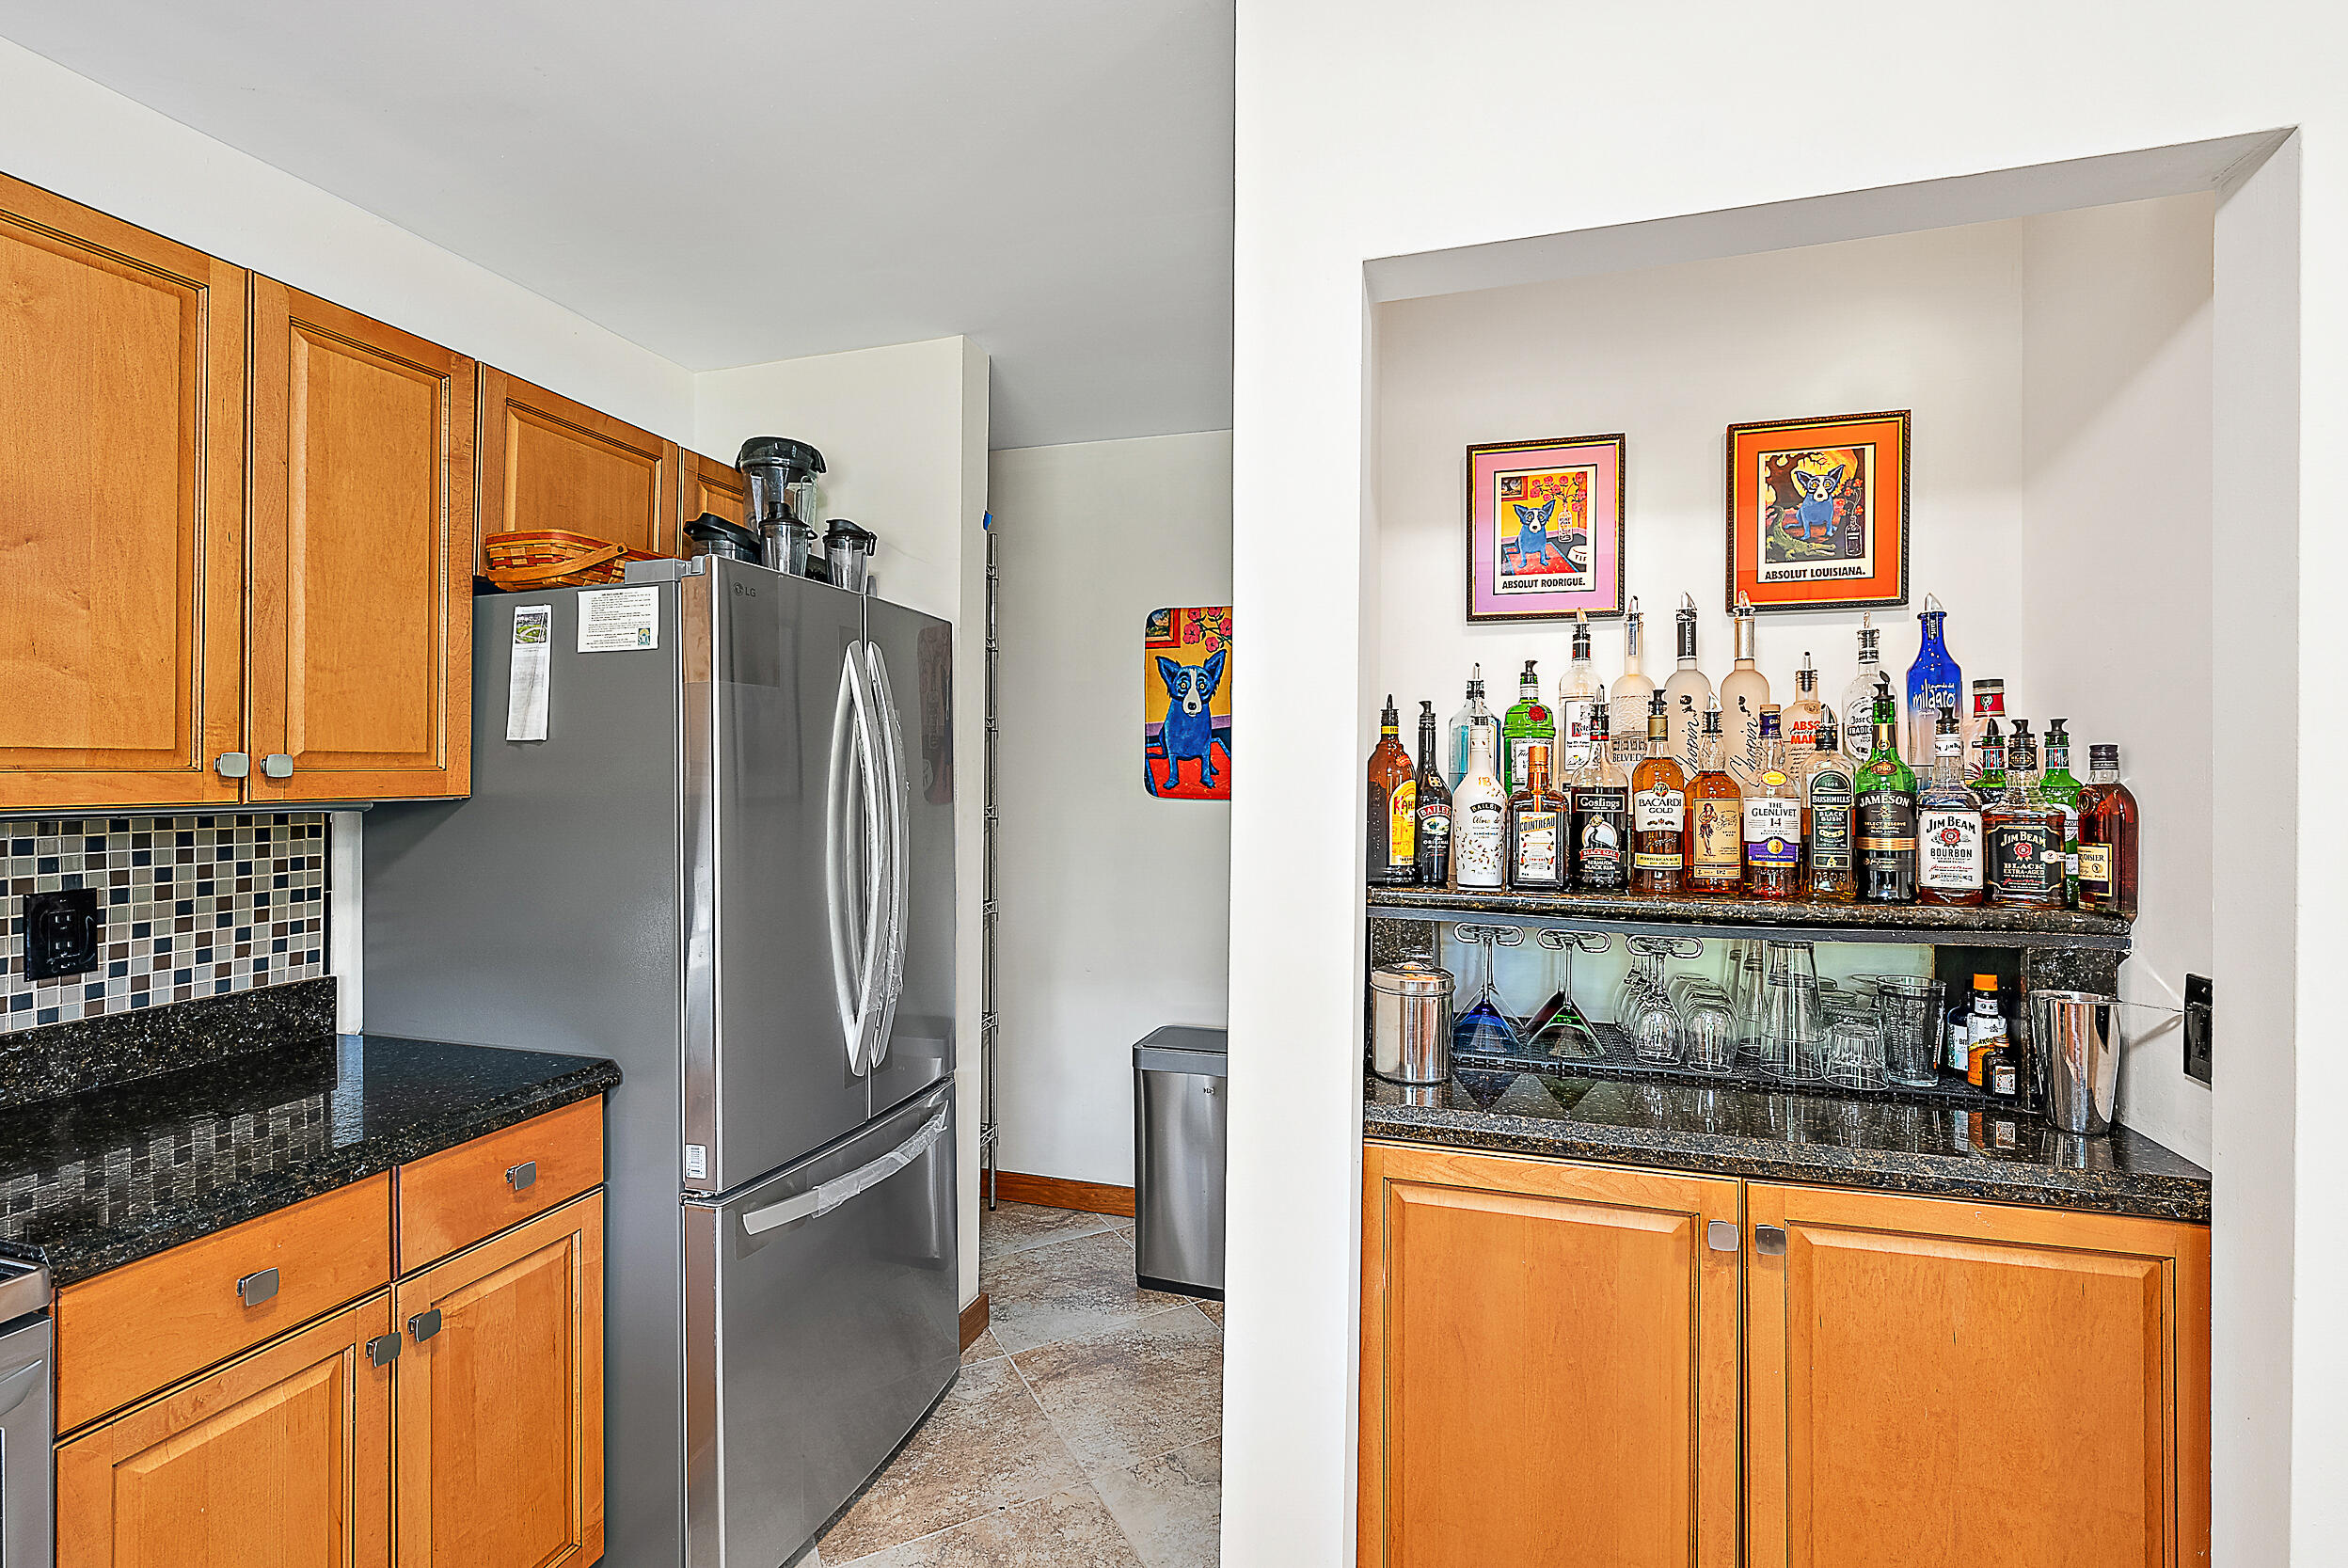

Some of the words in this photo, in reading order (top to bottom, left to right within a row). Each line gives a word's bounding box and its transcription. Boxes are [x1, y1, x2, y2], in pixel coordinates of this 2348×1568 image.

[1765, 568, 1807, 580] ABSOLUT
[1810, 566, 1866, 578] LOUISIANA.
[1501, 579, 1538, 590] ABSOLUT
[1541, 577, 1586, 588] RODRIGUE.
[745, 586, 756, 597] LG
[1912, 677, 1956, 710] milagro
[1393, 795, 1415, 816] KAH
[1579, 797, 1621, 811] Goslings
[1638, 798, 1682, 807] BACARDI
[1859, 795, 1911, 808] JAMESON
[1751, 807, 1798, 817] GLENLIVET
[1520, 816, 1556, 832] COINTREAU
[1769, 817, 1782, 827] 14
[1926, 820, 1945, 834] JIM
[1946, 816, 1976, 835] BEAM
[2001, 833, 2019, 847] JIM
[2019, 831, 2047, 848] BEAM
[1930, 847, 1973, 858] BOURBON
